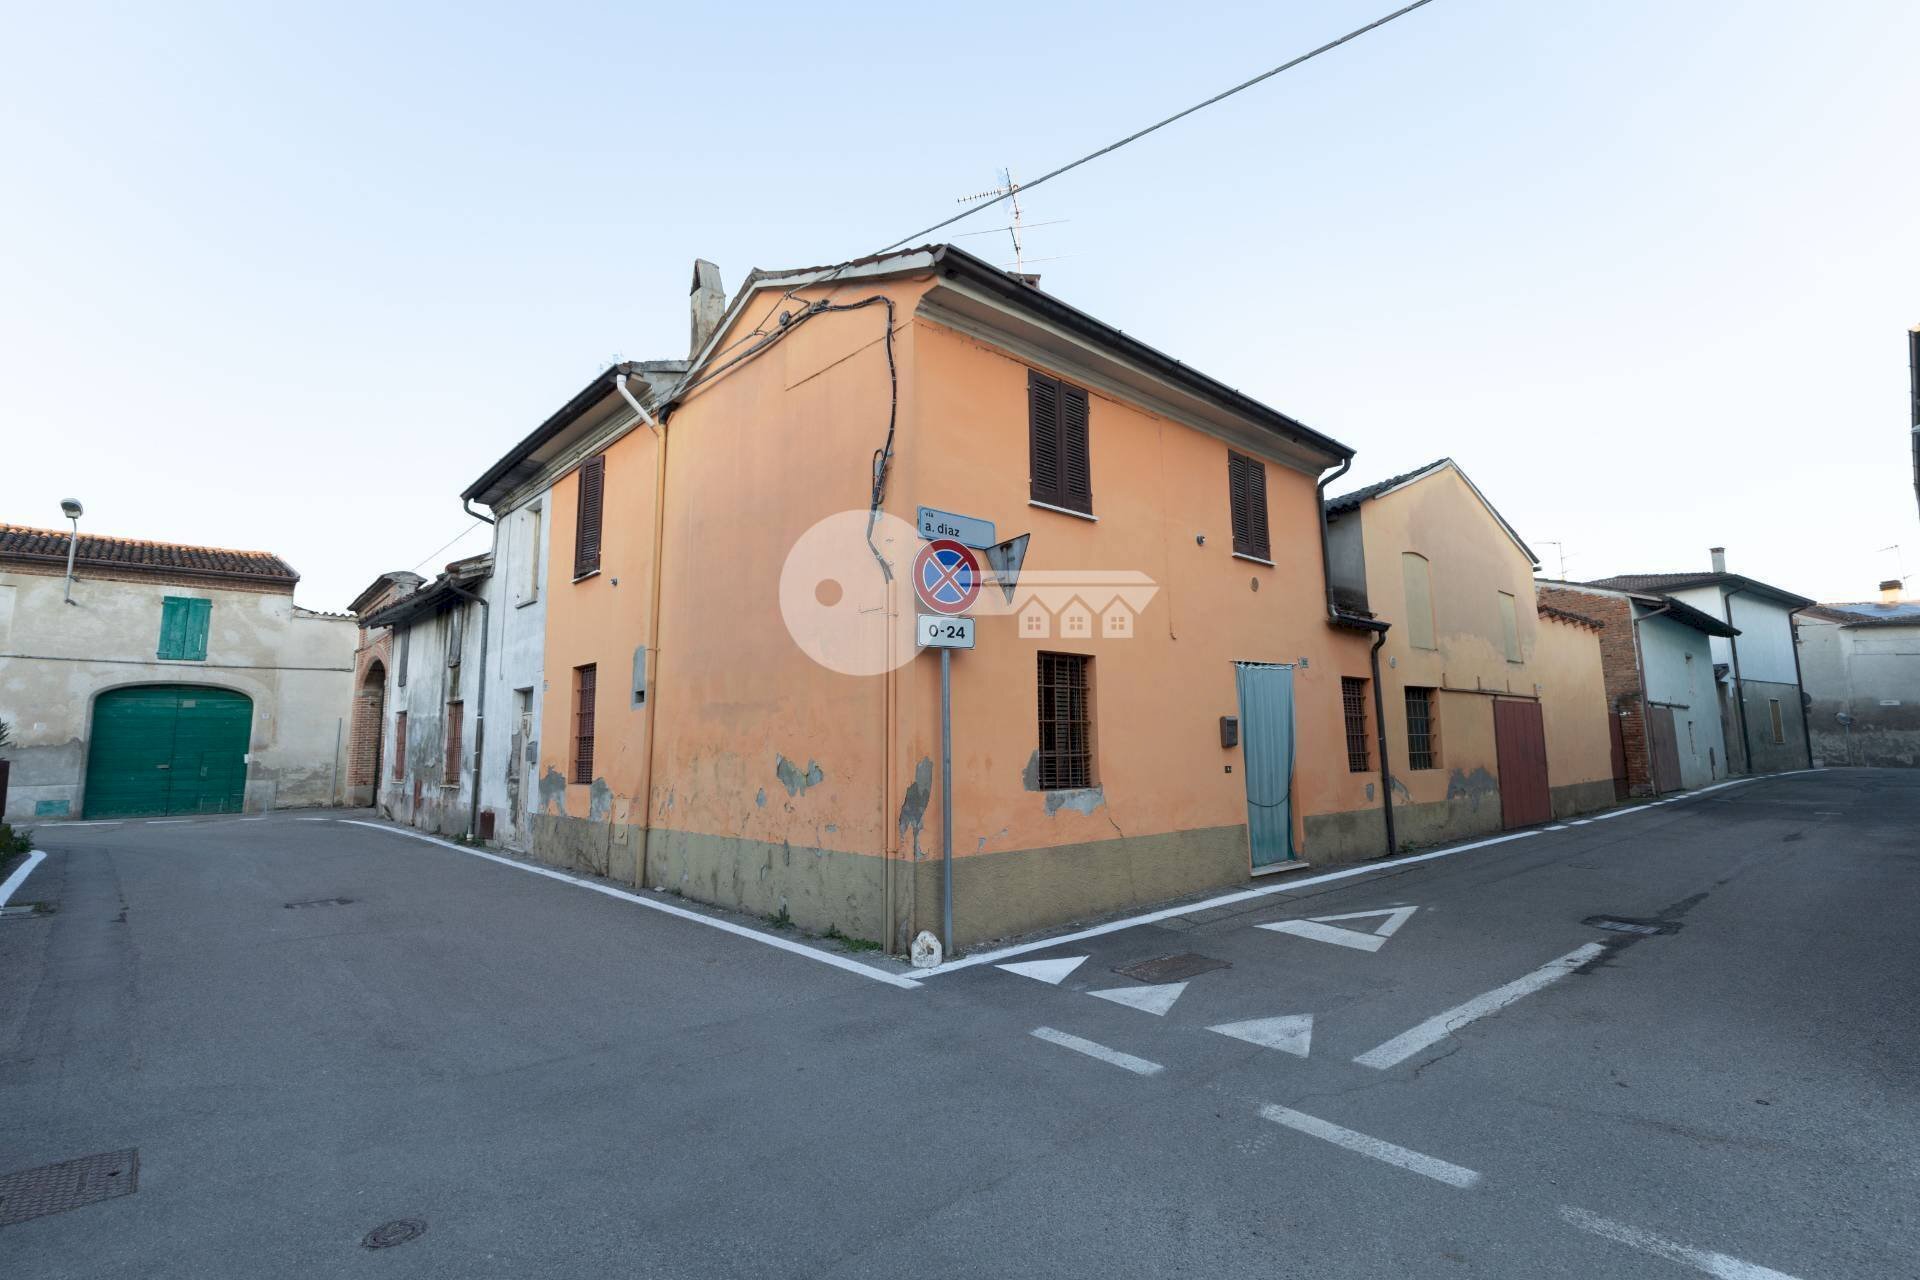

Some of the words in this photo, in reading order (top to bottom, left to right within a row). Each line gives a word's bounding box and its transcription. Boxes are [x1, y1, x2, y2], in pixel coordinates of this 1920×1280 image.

[925, 522, 935, 533] a.
[937, 523, 960, 538] diaz
[928, 624, 966, 639] 0-24
